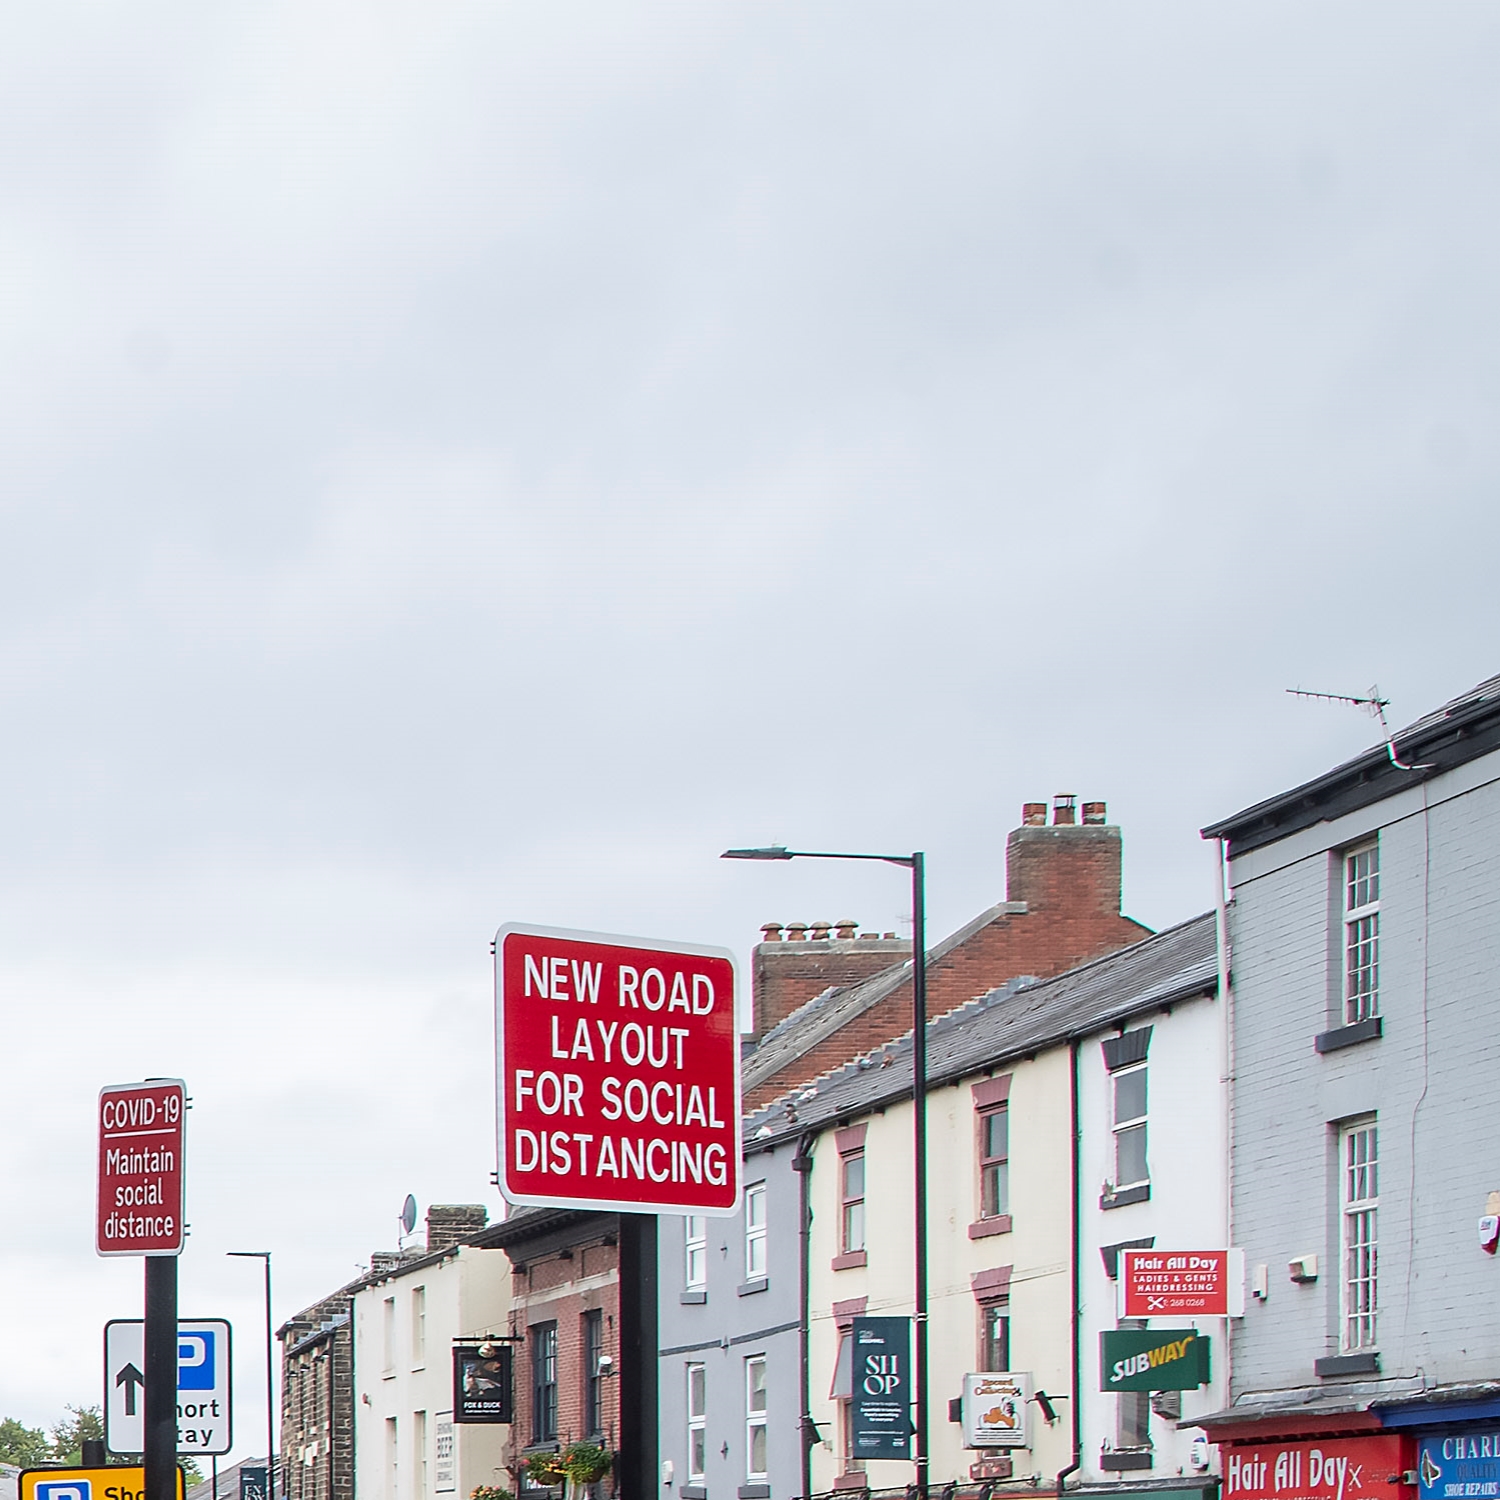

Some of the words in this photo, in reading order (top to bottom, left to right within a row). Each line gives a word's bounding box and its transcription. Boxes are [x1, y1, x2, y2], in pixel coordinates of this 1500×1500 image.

[524, 953, 603, 1004] NEW
[618, 964, 716, 1016] ROAD
[551, 1015, 690, 1070] LAYOUT
[102, 1094, 180, 1130] COVID-19
[515, 1068, 585, 1117] FOR
[600, 1075, 726, 1129] SOCIAL
[105, 1144, 174, 1177] Maintain
[515, 1128, 728, 1187] DISTANCING
[115, 1176, 164, 1208] social
[104, 1210, 175, 1239] distance
[1132, 1275, 1170, 1283] LADIES
[1173, 1274, 1180, 1283] &
[1184, 1273, 1218, 1282] GENTS
[1133, 1256, 1164, 1271] Hair
[1166, 1256, 1187, 1271] All
[1188, 1256, 1219, 1272] Day
[1137, 1283, 1214, 1292] HAIRDRESSING
[865, 1354, 898, 1375] SH
[1109, 1335, 1195, 1383] SUBWAY
[863, 1374, 901, 1396] OP
[176, 1398, 221, 1418] ort
[463, 1401, 477, 1409] FOX
[477, 1401, 483, 1409] &
[483, 1401, 502, 1409] DUCK
[176, 1429, 214, 1447] ay
[1227, 1454, 1267, 1495] Hair
[1274, 1450, 1301, 1491] All
[1443, 1482, 1463, 1497] SHOE
[1464, 1481, 1498, 1496] REPAIRS
